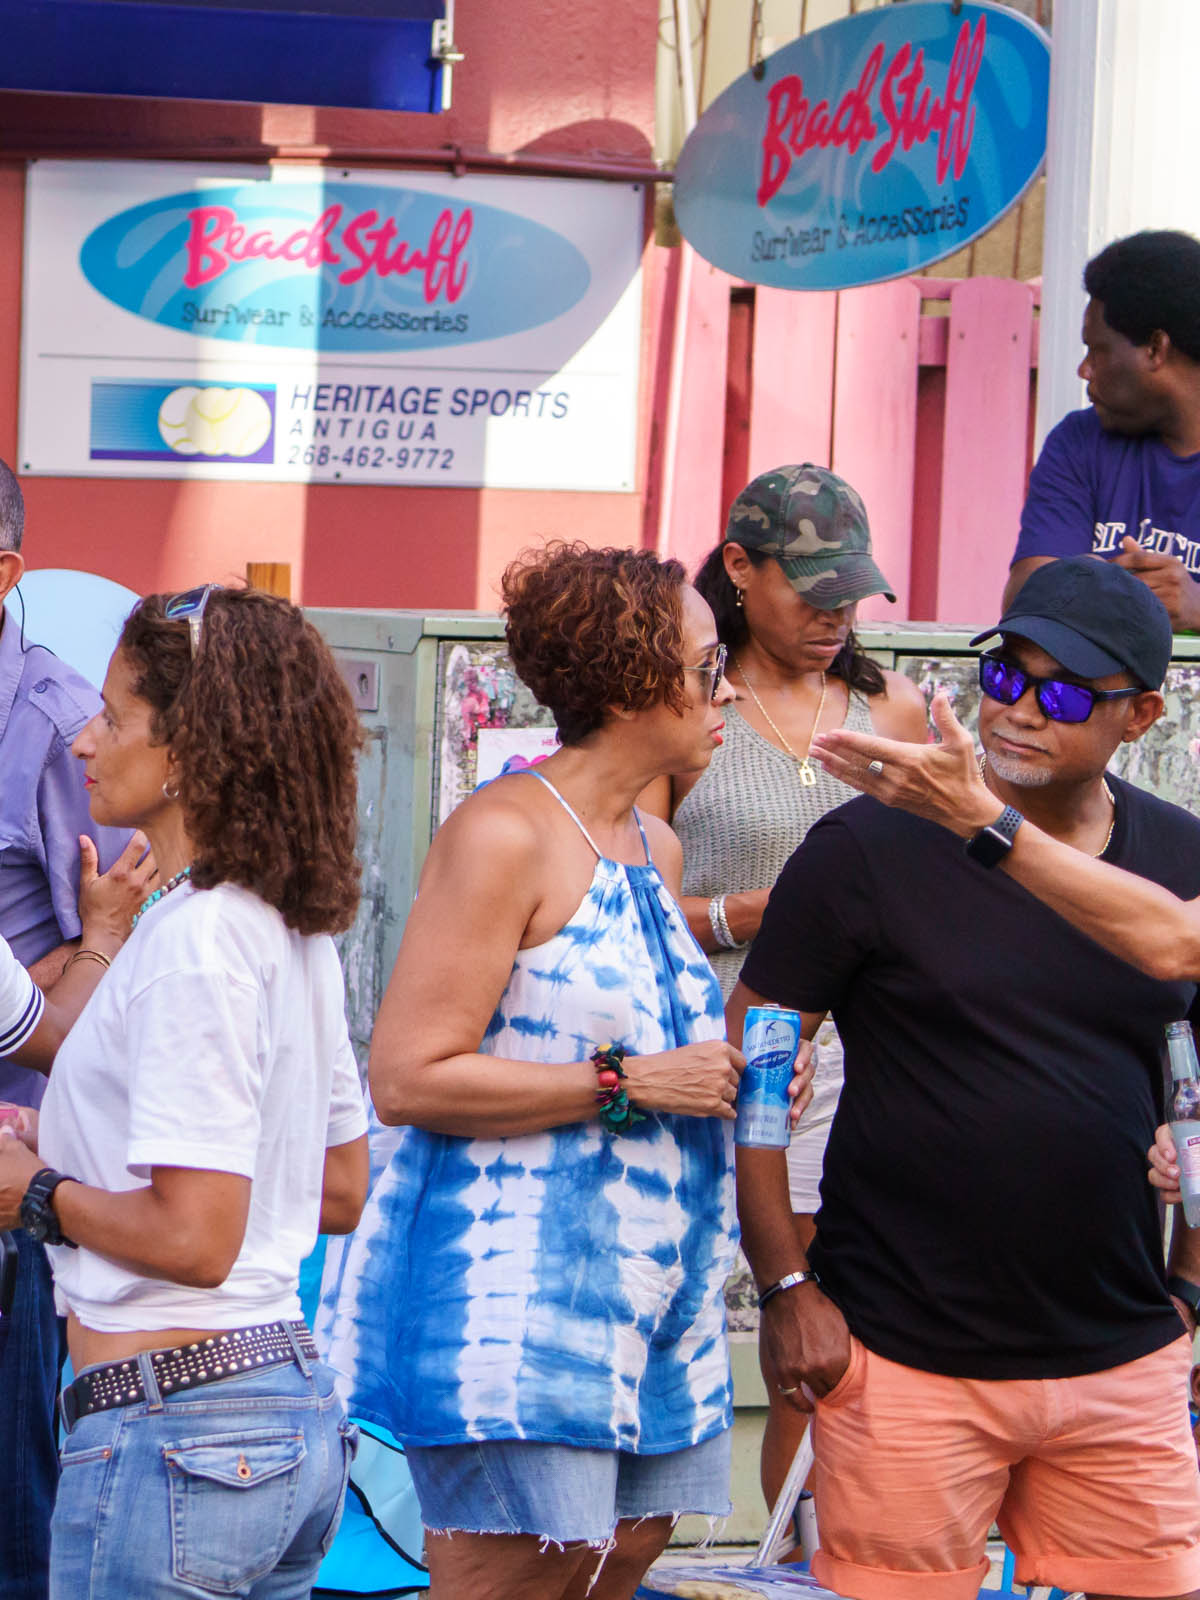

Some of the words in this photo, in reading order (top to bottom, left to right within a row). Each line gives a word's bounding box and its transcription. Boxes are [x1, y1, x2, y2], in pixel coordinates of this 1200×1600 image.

[757, 42, 884, 207] Beach
[871, 13, 986, 185] Stuff
[752, 225, 832, 262] Surfwear
[836, 214, 849, 249] &
[853, 195, 969, 246] Accessories
[182, 204, 343, 289] Beach
[338, 207, 473, 304] Stuff
[181, 302, 292, 328] Surfwear
[299, 306, 315, 328] &
[321, 308, 469, 333] Accessories
[290, 383, 443, 415] HERITAGE
[449, 388, 570, 419] SPORTS
[289, 418, 437, 441] ANTIGUA
[288, 445, 455, 470] 268-462-9772
